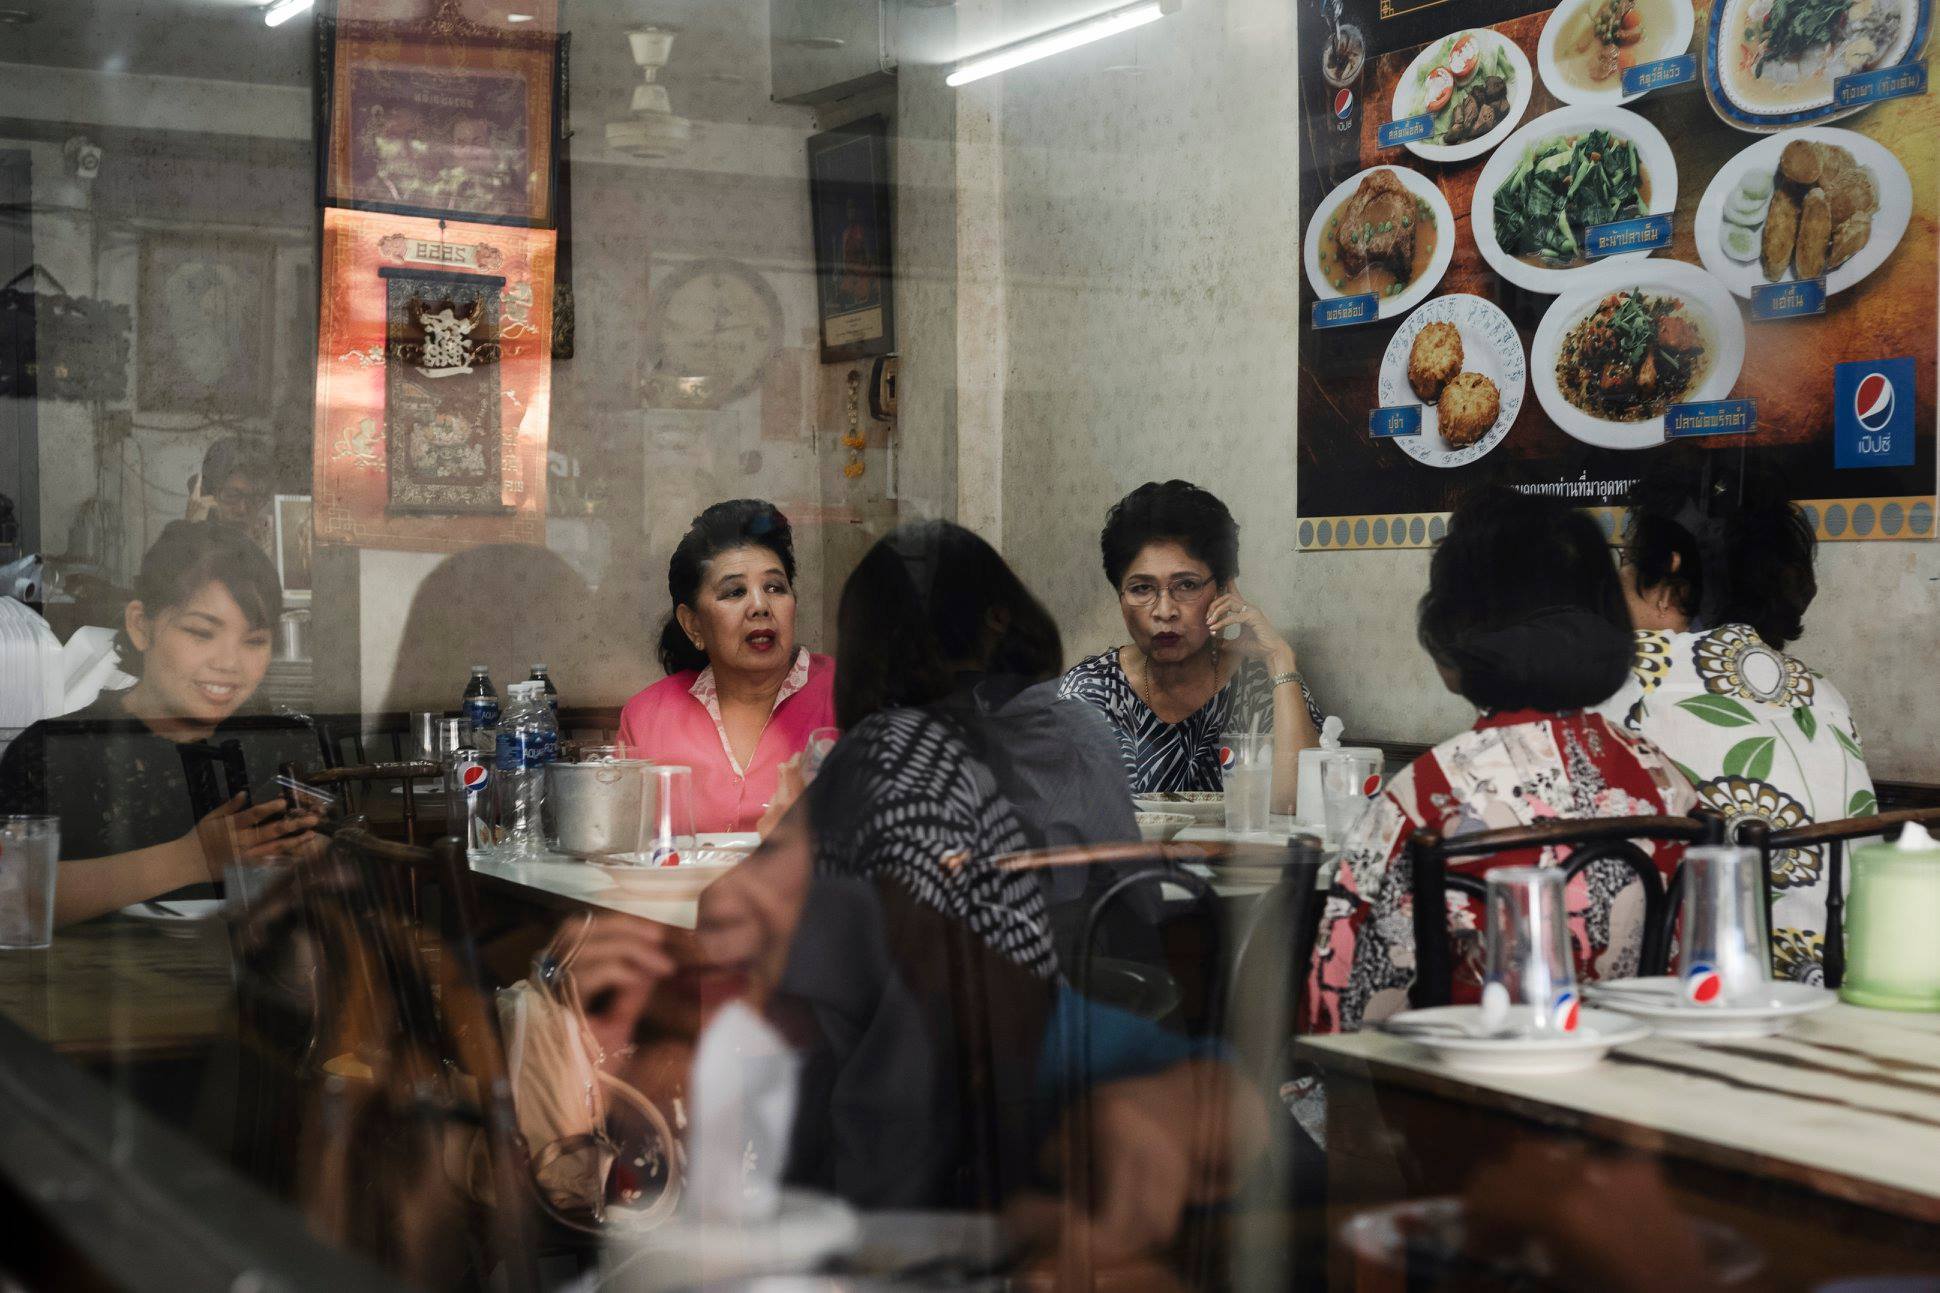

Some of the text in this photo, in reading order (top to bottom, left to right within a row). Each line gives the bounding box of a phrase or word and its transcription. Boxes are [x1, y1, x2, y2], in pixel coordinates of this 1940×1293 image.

[1599, 222, 1658, 248] คะน้าปลาเค็ม
[1858, 432, 1891, 453] เป๊ปซี่
